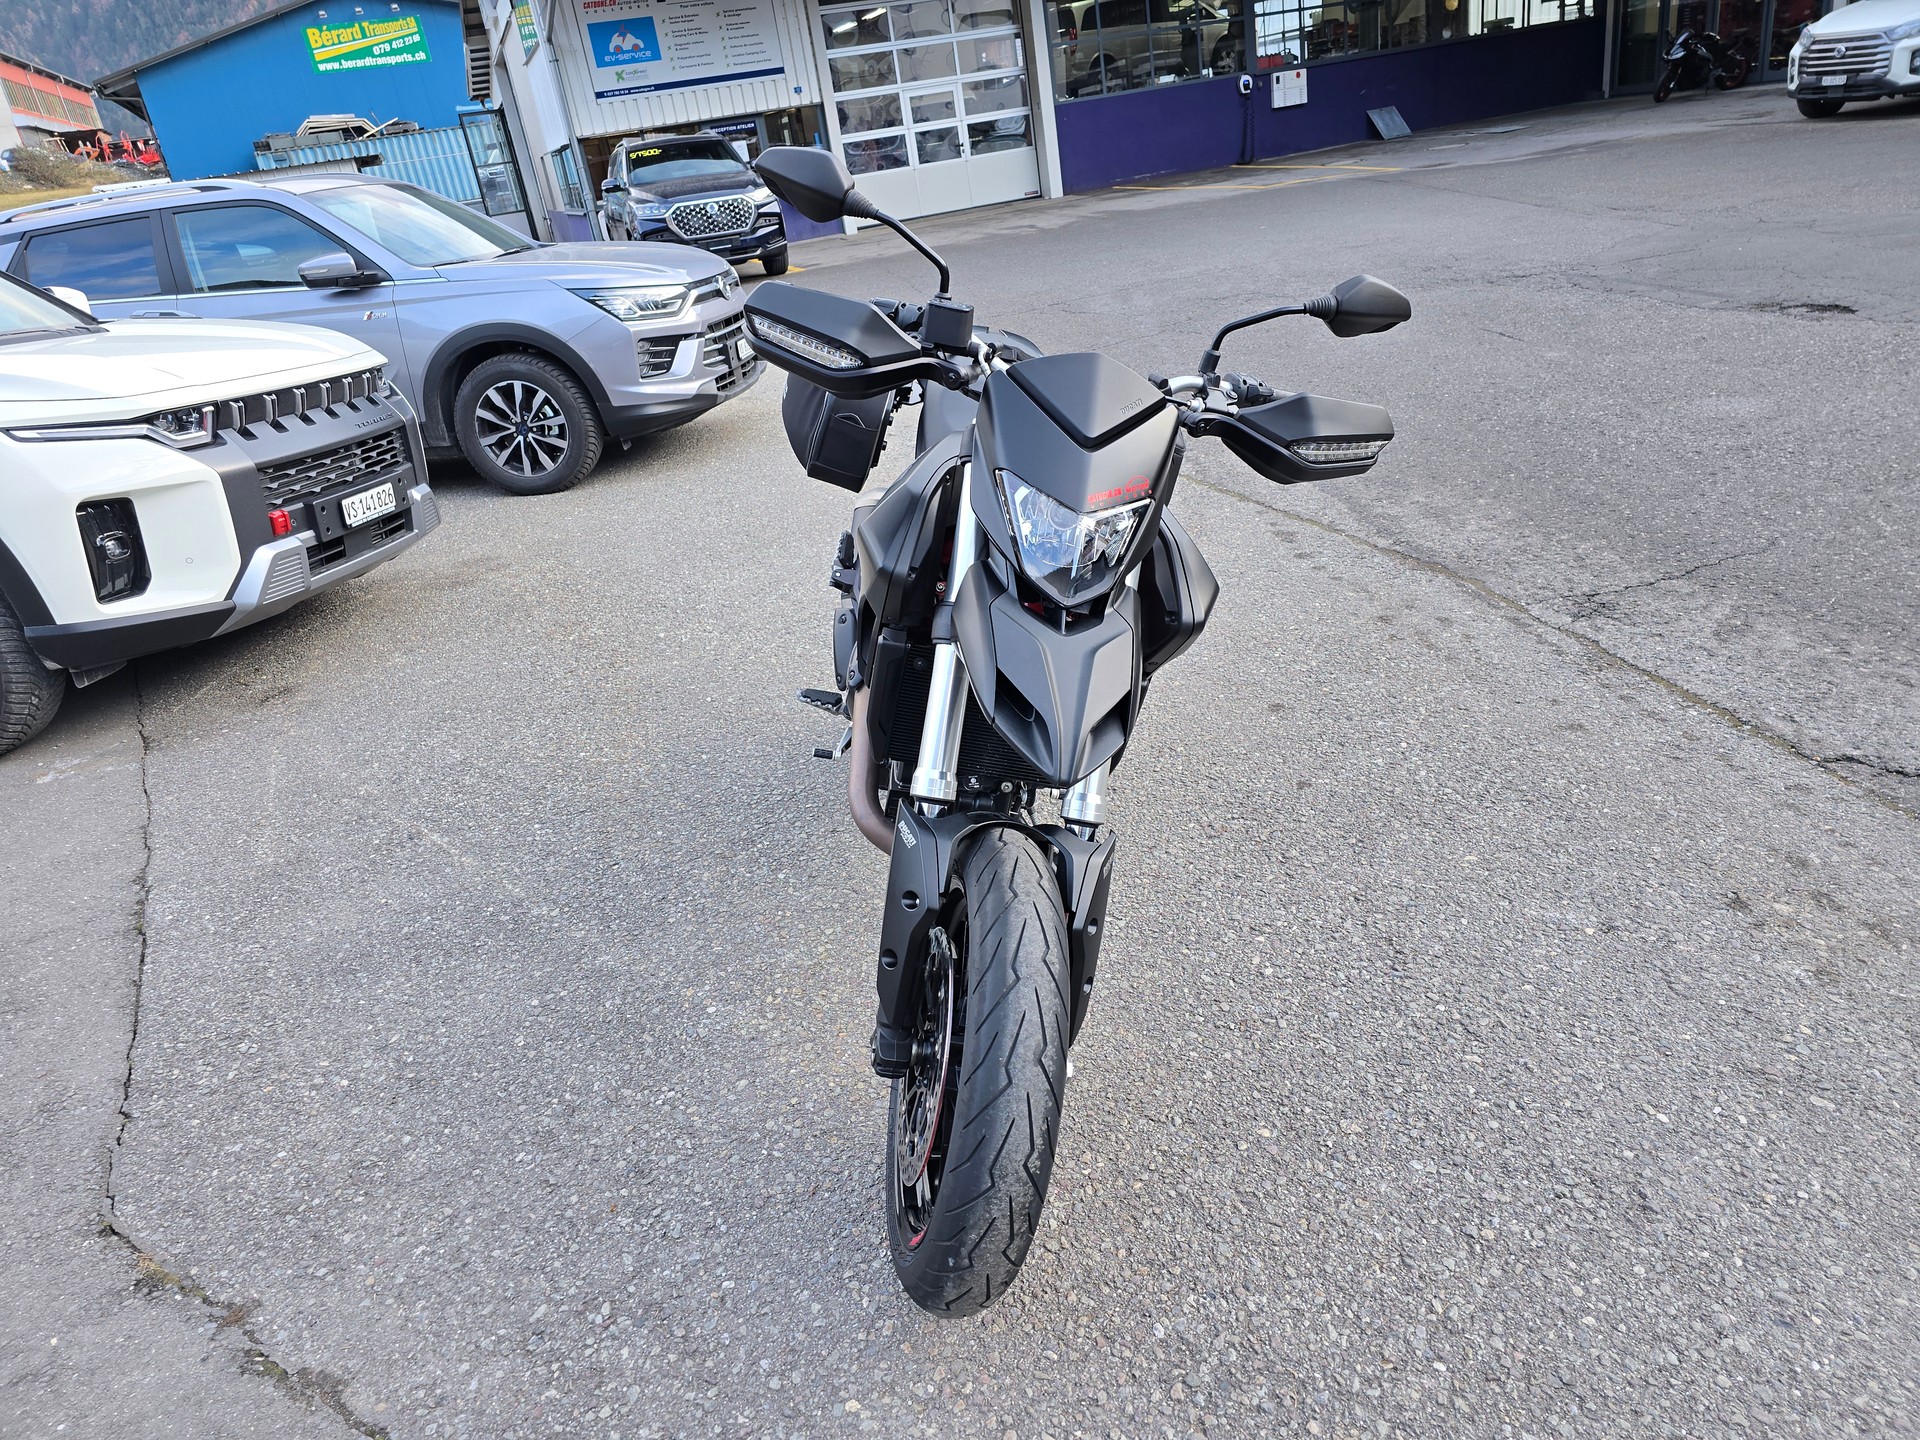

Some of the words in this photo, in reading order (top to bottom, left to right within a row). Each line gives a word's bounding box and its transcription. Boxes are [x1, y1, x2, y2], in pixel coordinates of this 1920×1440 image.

[306, 23, 362, 49] Bérard
[362, 18, 408, 37] Transports
[372, 43, 390, 55] 079
[392, 39, 404, 49] 412
[317, 51, 426, 71] www.berardtransports.ch
[604, 50, 652, 62] ev-service
[1120, 398, 1143, 414] DUCATI
[355, 412, 394, 429] TORRES
[898, 820, 917, 847] DUCATI
